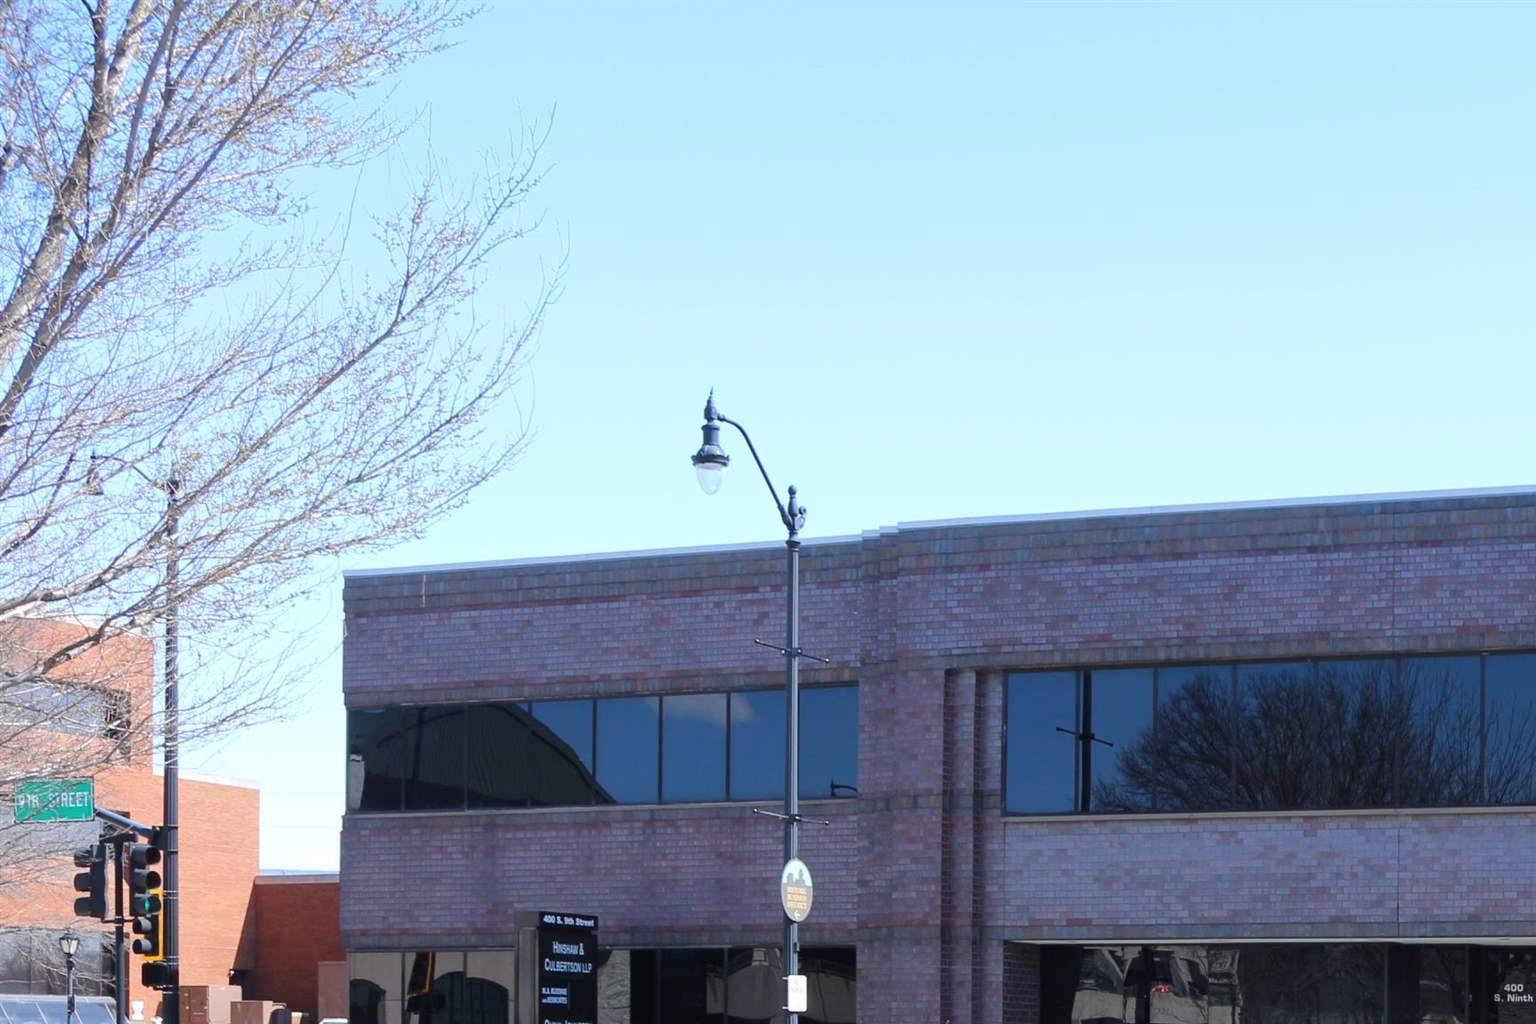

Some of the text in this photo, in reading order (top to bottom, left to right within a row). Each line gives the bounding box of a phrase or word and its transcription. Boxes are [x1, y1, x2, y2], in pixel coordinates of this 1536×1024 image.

[47, 791, 89, 807] STREET
[575, 917, 595, 927] Street
[1504, 983, 1524, 992] 400
[1494, 993, 1534, 1003] S. Ninth
